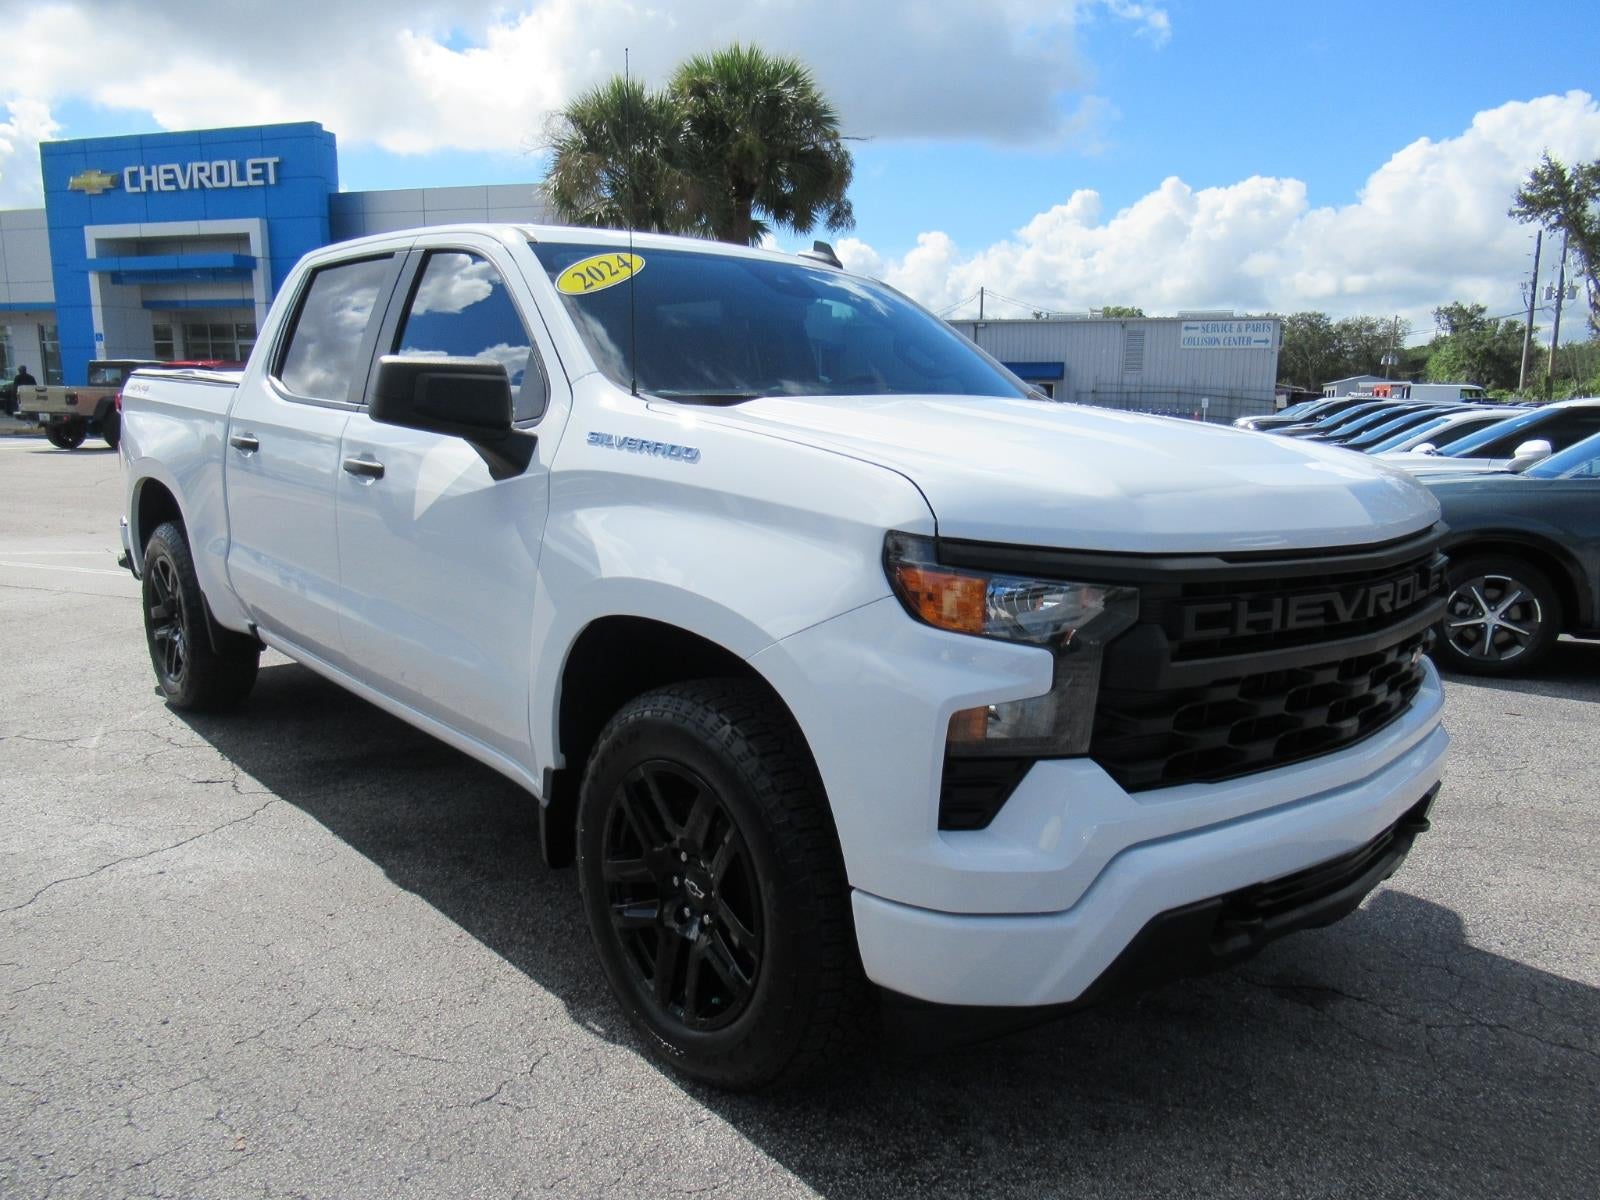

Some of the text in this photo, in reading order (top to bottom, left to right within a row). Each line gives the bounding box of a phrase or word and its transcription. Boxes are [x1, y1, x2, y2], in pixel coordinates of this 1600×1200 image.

[123, 157, 279, 193] CHEVROLET
[572, 254, 631, 290] 2024
[1182, 336, 1252, 346] COLLISION CENTER
[1201, 322, 1272, 333] SERVICE & PARTS
[587, 431, 701, 464] SILVERADO
